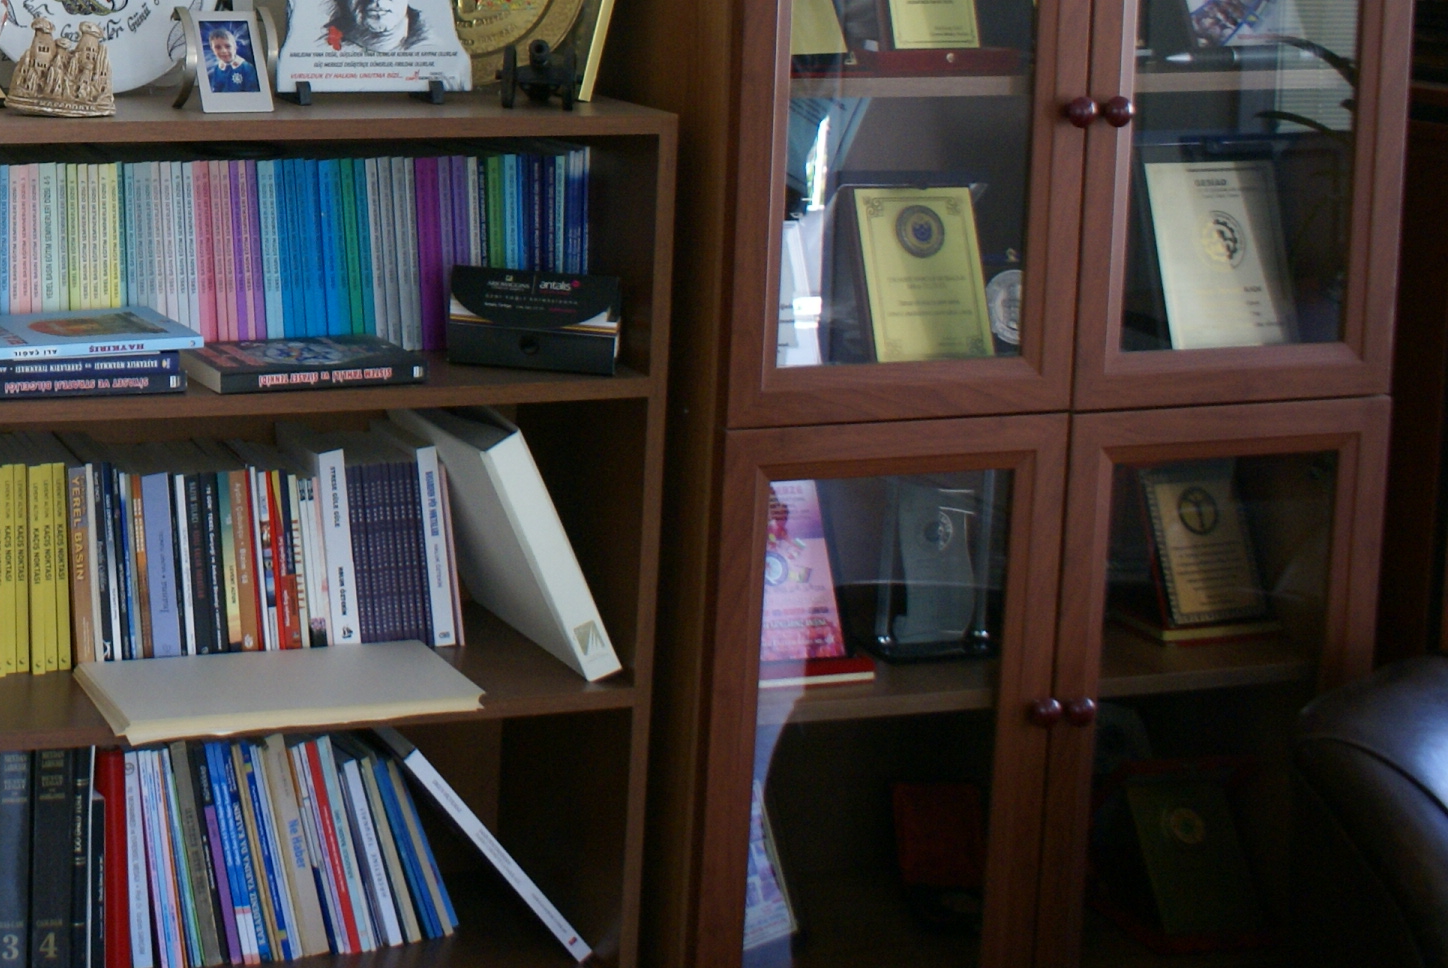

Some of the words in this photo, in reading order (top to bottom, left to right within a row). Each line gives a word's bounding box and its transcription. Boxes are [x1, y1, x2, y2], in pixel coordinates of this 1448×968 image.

[44, 244, 53, 262] EĞİTİM
[45, 264, 53, 281] BASIN
[539, 281, 571, 291] antalis
[14, 349, 39, 357] ÇAĞIL
[89, 343, 144, 353] HAYKIRIŞ
[259, 373, 289, 388] TENKİDİ
[290, 372, 319, 385] SİYASET
[332, 369, 362, 383] TAHLİLİ
[364, 367, 392, 380] SİSTEM
[4, 381, 52, 394] BİLGELİĞİ
[54, 379, 95, 392] STRATEJİ
[98, 379, 110, 389] VE
[113, 377, 149, 389] SİYASET
[330, 466, 338, 491] STRESE
[71, 476, 82, 527] YEREL
[333, 511, 341, 527] GÜLE
[4, 526, 12, 548] KAÇIŞ
[74, 532, 85, 580] BASIN
[239, 548, 247, 571] Bizim
[288, 819, 299, 834] Ne
[238, 840, 248, 854] DA
[291, 837, 307, 868] Haber
[242, 855, 260, 890] YARINA
[249, 892, 266, 945] KARADENİZ
[2, 934, 19, 960] 3
[39, 932, 58, 959] 4
